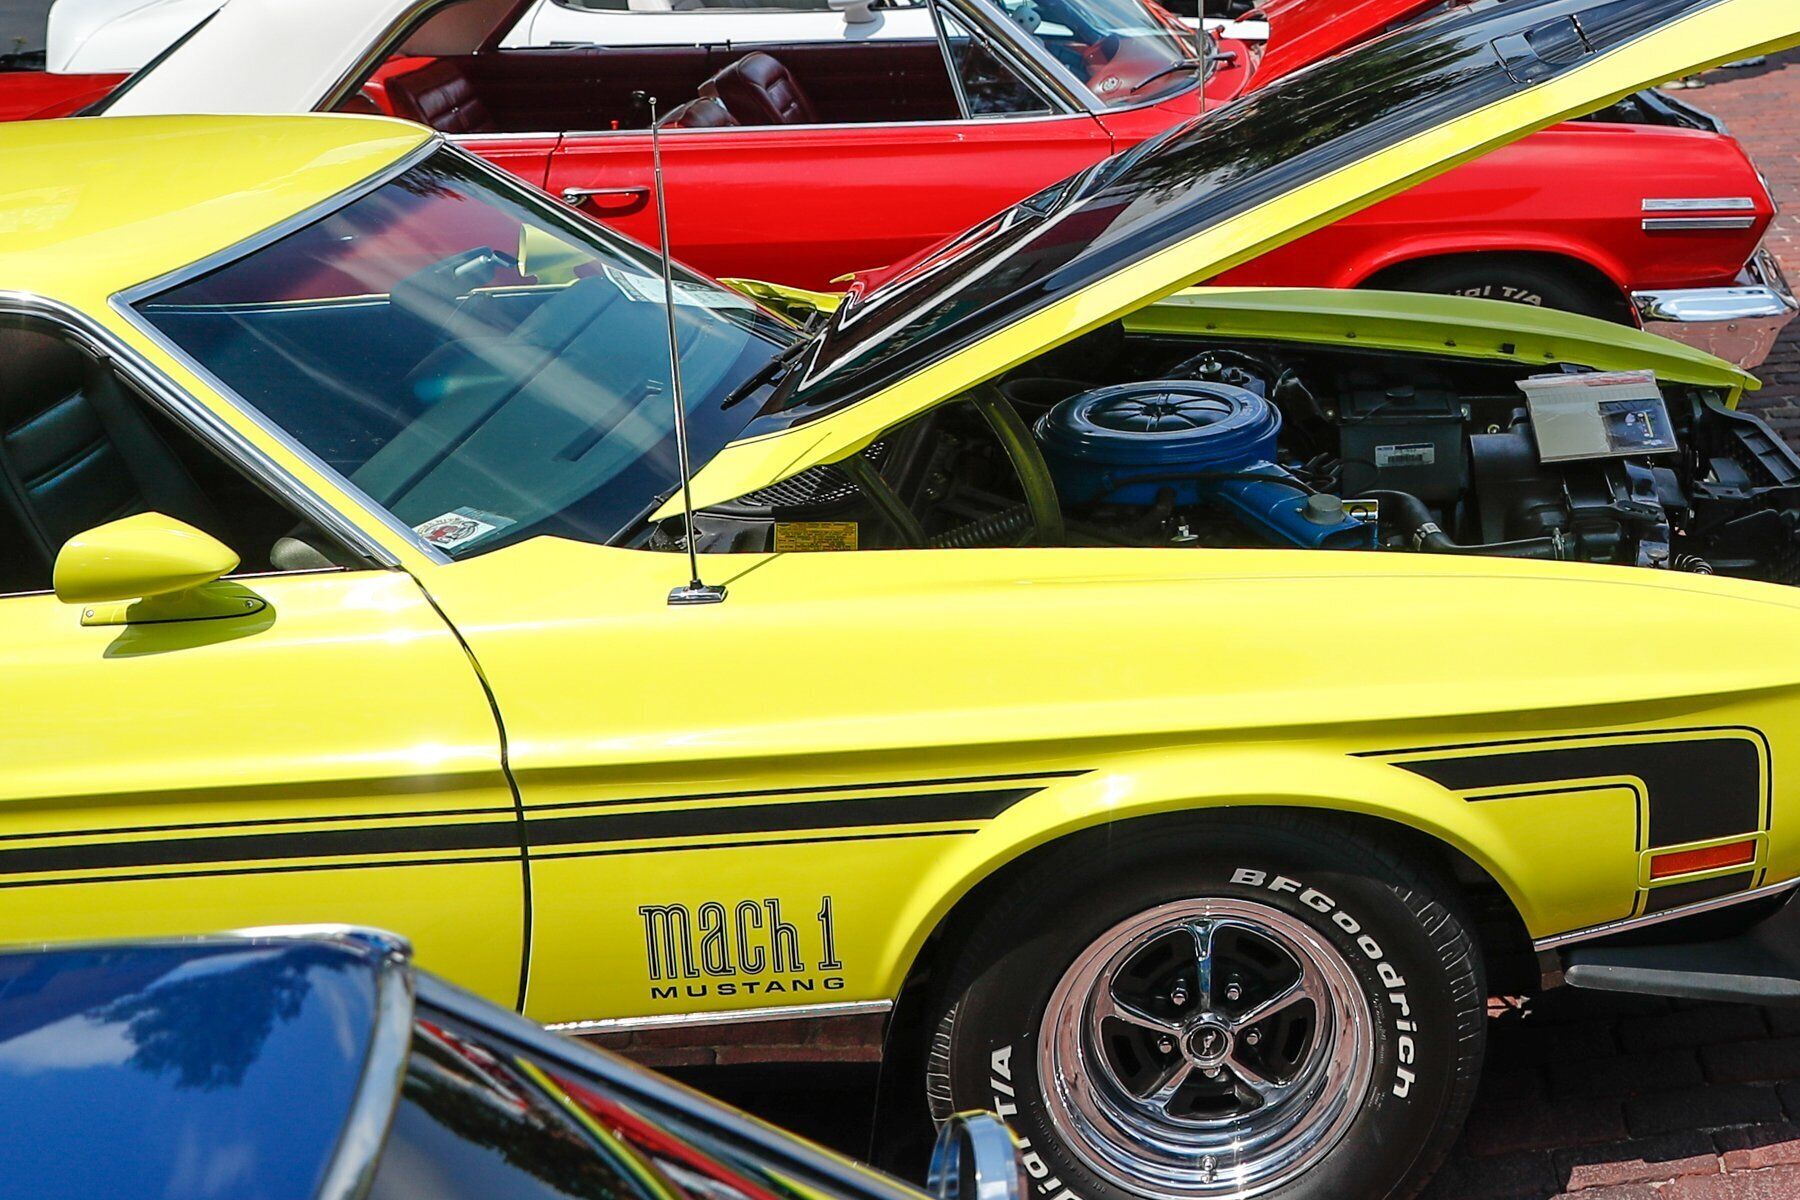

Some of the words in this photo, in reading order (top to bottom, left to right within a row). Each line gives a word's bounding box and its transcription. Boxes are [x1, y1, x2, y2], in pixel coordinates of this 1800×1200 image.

[1502, 286, 1542, 306] T/A
[638, 898, 805, 980] mach
[817, 895, 842, 970] 1
[651, 977, 845, 999] MUSTANG
[1229, 868, 1418, 1099] BFGoodrich
[990, 1045, 1017, 1123] T/A
